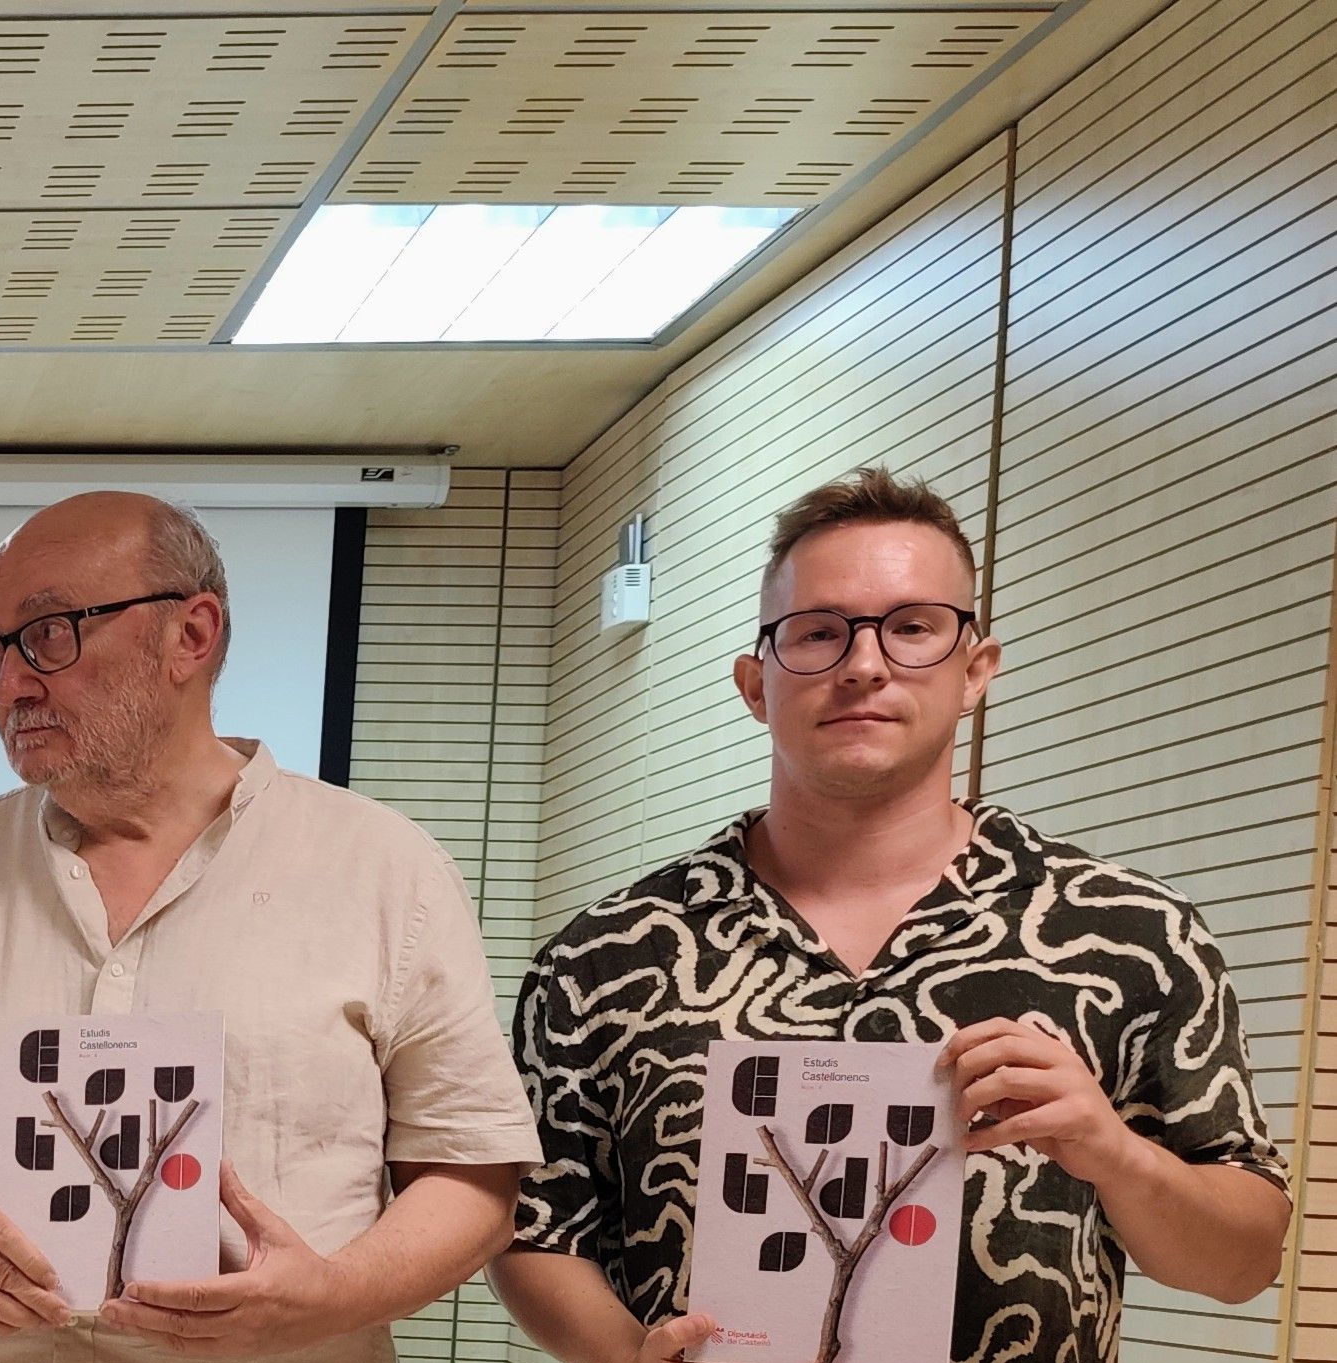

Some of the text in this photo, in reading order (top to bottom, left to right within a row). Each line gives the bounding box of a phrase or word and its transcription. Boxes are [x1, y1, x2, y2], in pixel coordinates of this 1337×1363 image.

[80, 1029, 110, 1038] Estudis
[79, 1040, 138, 1050] Castellonencs
[803, 1057, 839, 1068] Estudis
[802, 1071, 870, 1083] Castellonencs
[727, 1329, 768, 1340] Diputació
